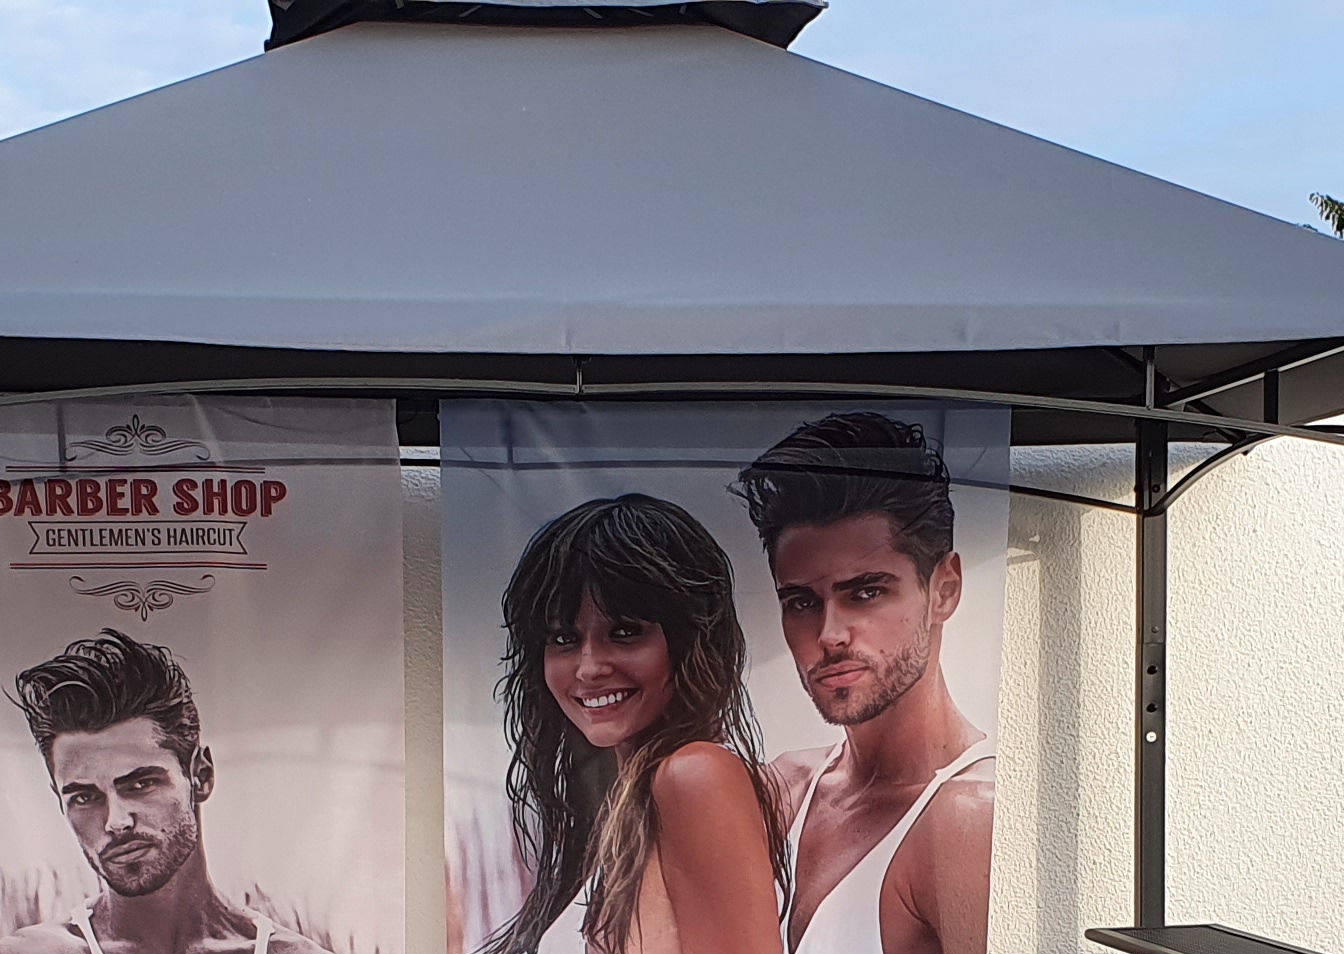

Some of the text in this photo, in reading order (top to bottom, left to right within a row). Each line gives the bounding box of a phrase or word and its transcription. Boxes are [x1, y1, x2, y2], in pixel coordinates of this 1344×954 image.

[172, 478, 287, 517] SHOP
[45, 527, 235, 547] GENTLEMEN'S HAIRCUT
